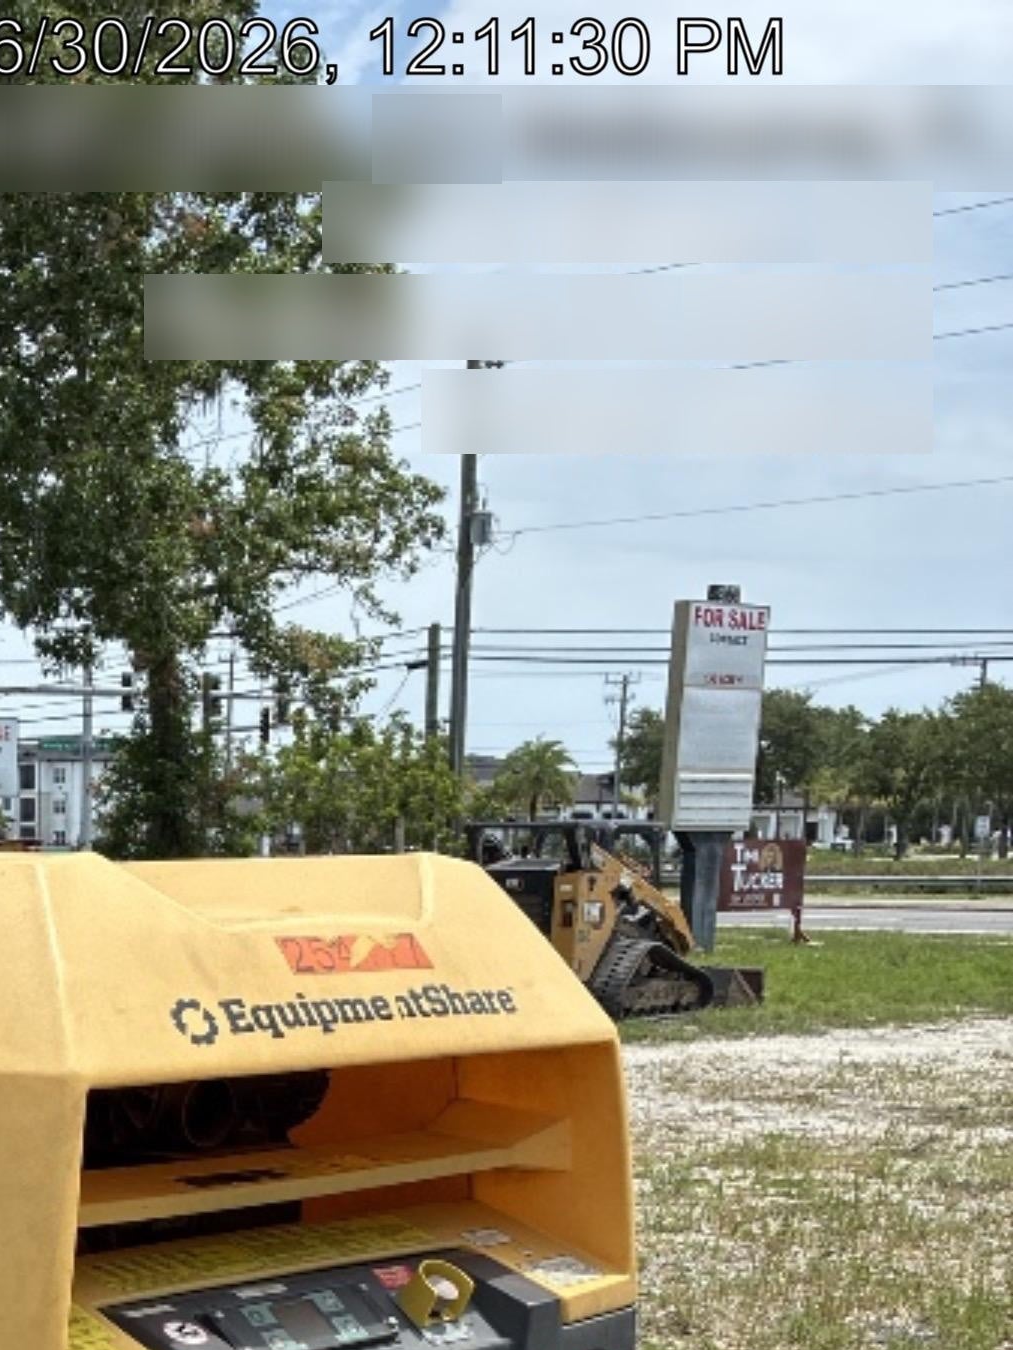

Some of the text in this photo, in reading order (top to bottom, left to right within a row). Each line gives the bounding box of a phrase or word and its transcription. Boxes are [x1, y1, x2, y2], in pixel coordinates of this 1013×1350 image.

[694, 606, 765, 632] FOR SALE
[218, 984, 517, 1039] EquipmentShare
